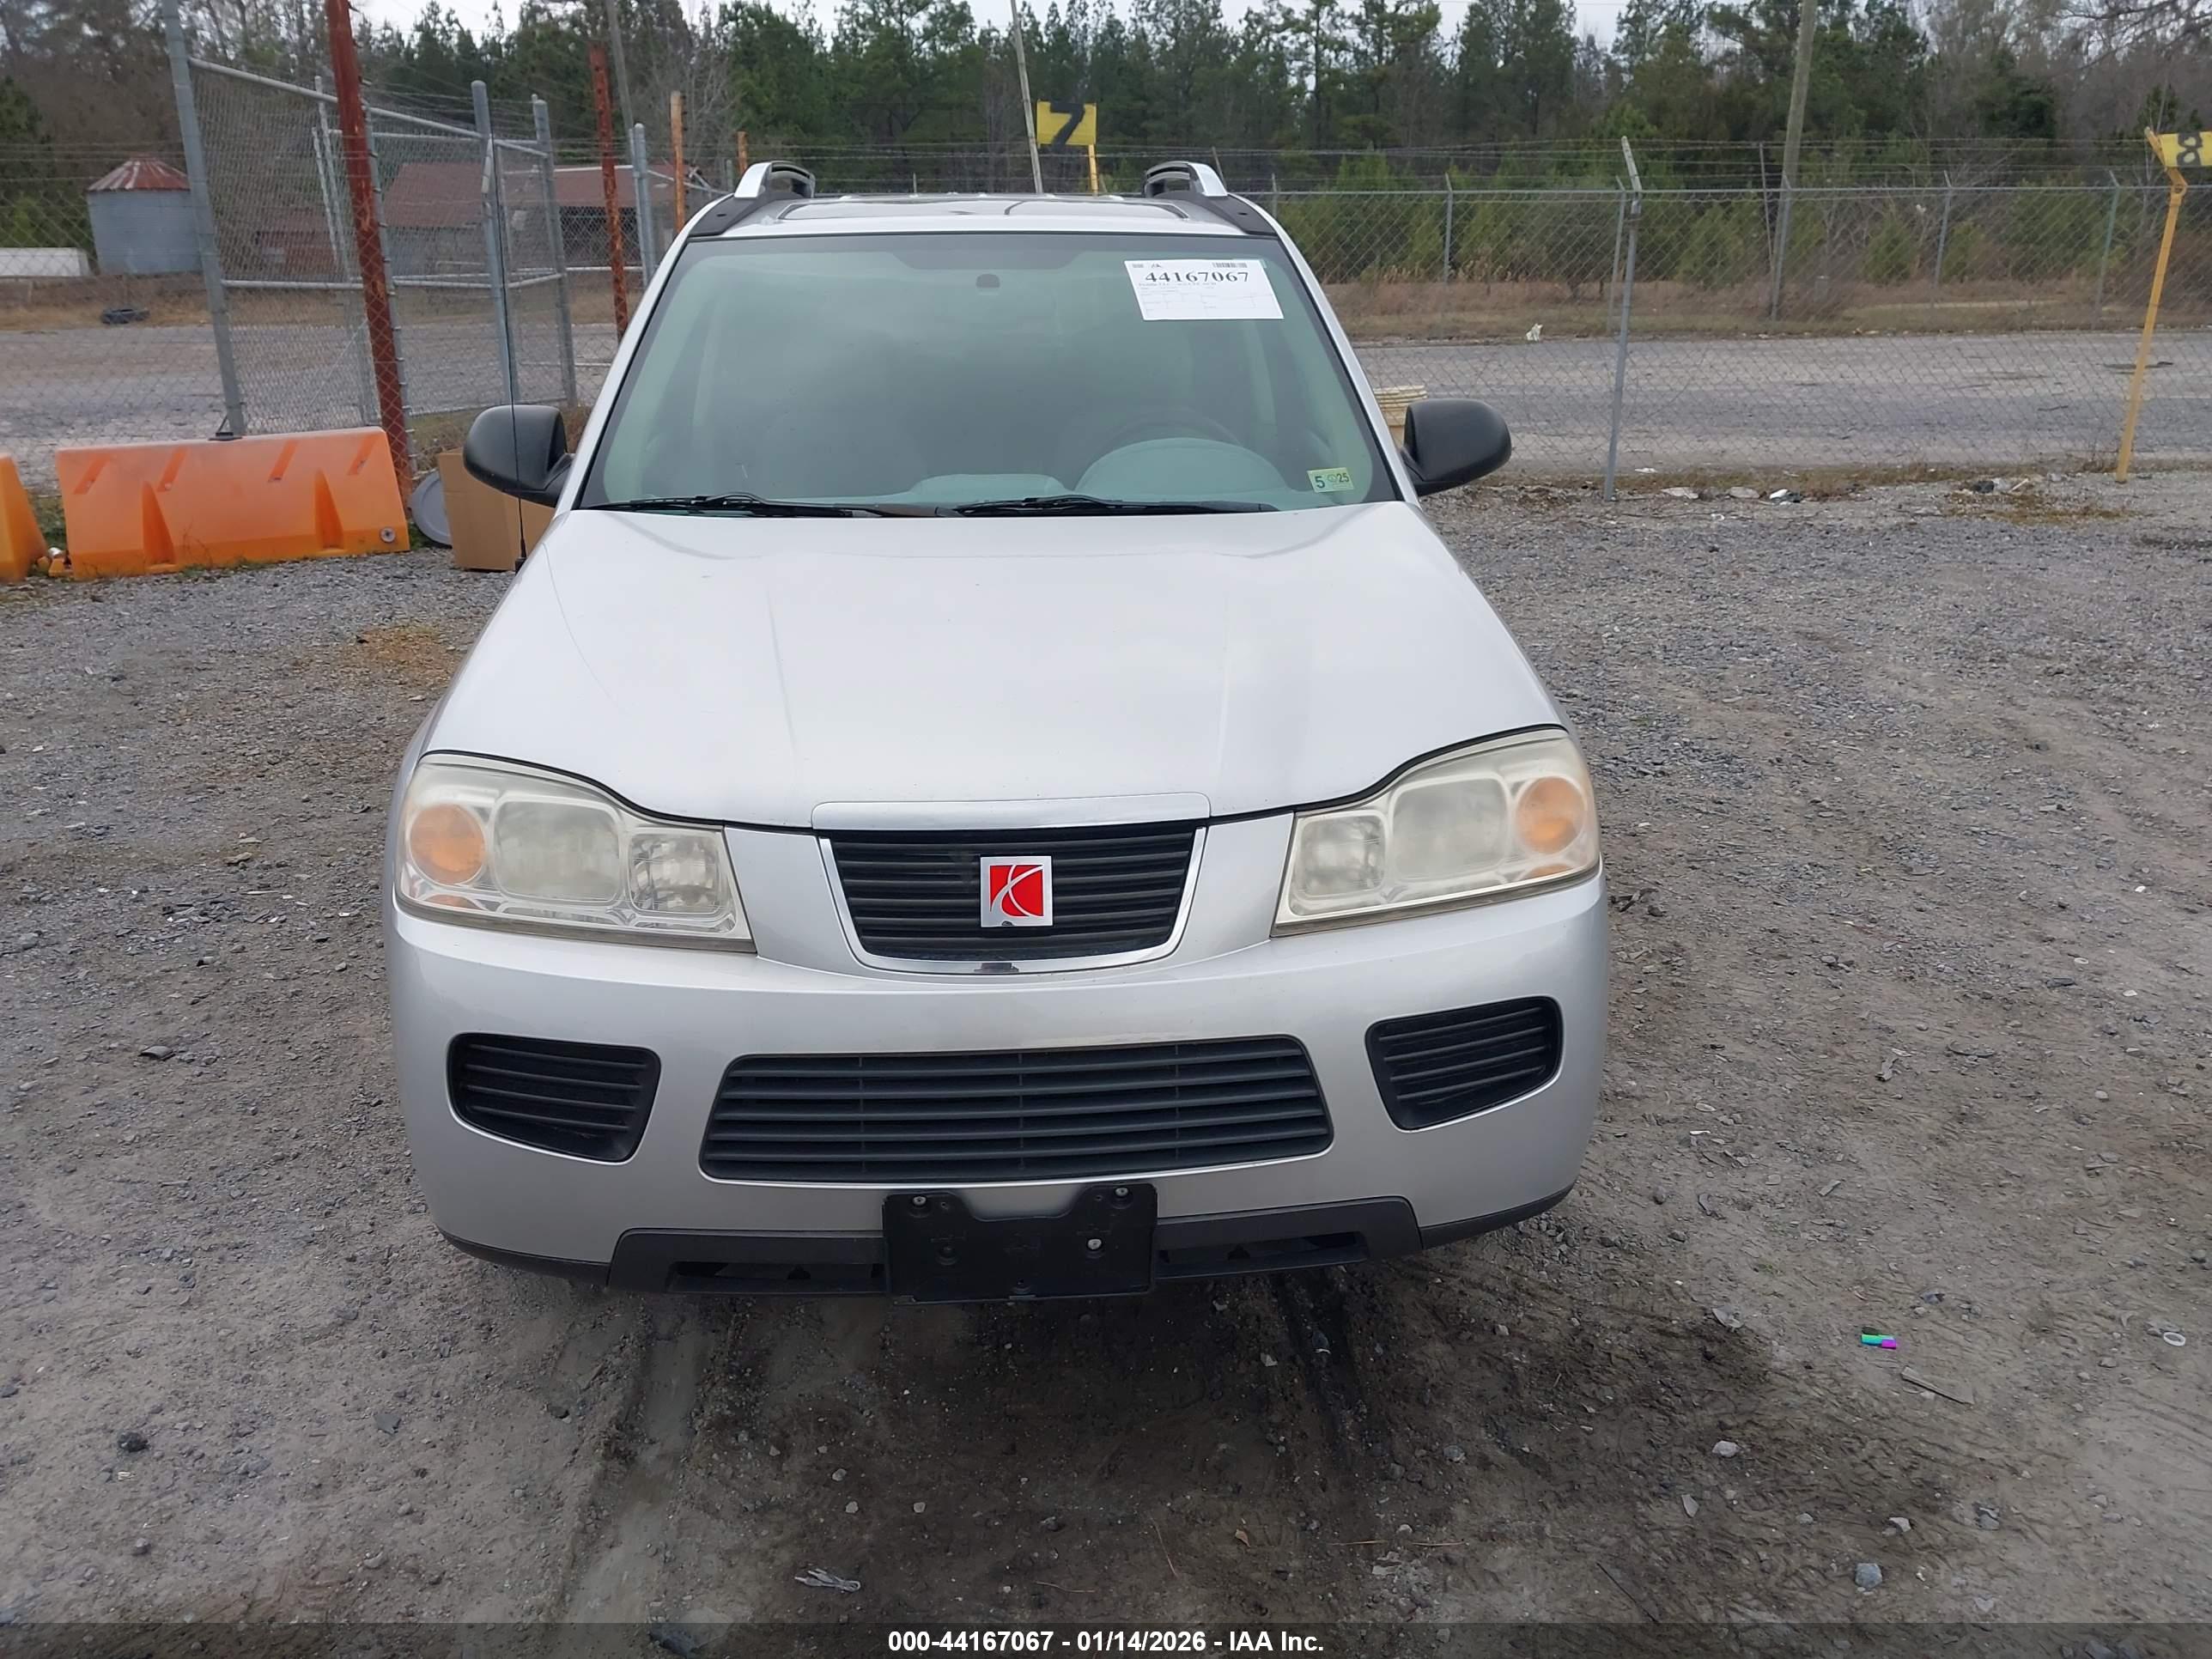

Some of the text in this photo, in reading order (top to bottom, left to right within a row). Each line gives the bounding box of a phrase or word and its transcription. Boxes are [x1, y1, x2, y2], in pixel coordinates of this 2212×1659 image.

[1049, 100, 1085, 149] 7
[2176, 132, 2203, 167] 8
[1145, 270, 1249, 283] 44167067
[1315, 475, 1326, 489] 5
[1336, 472, 1350, 483] 25
